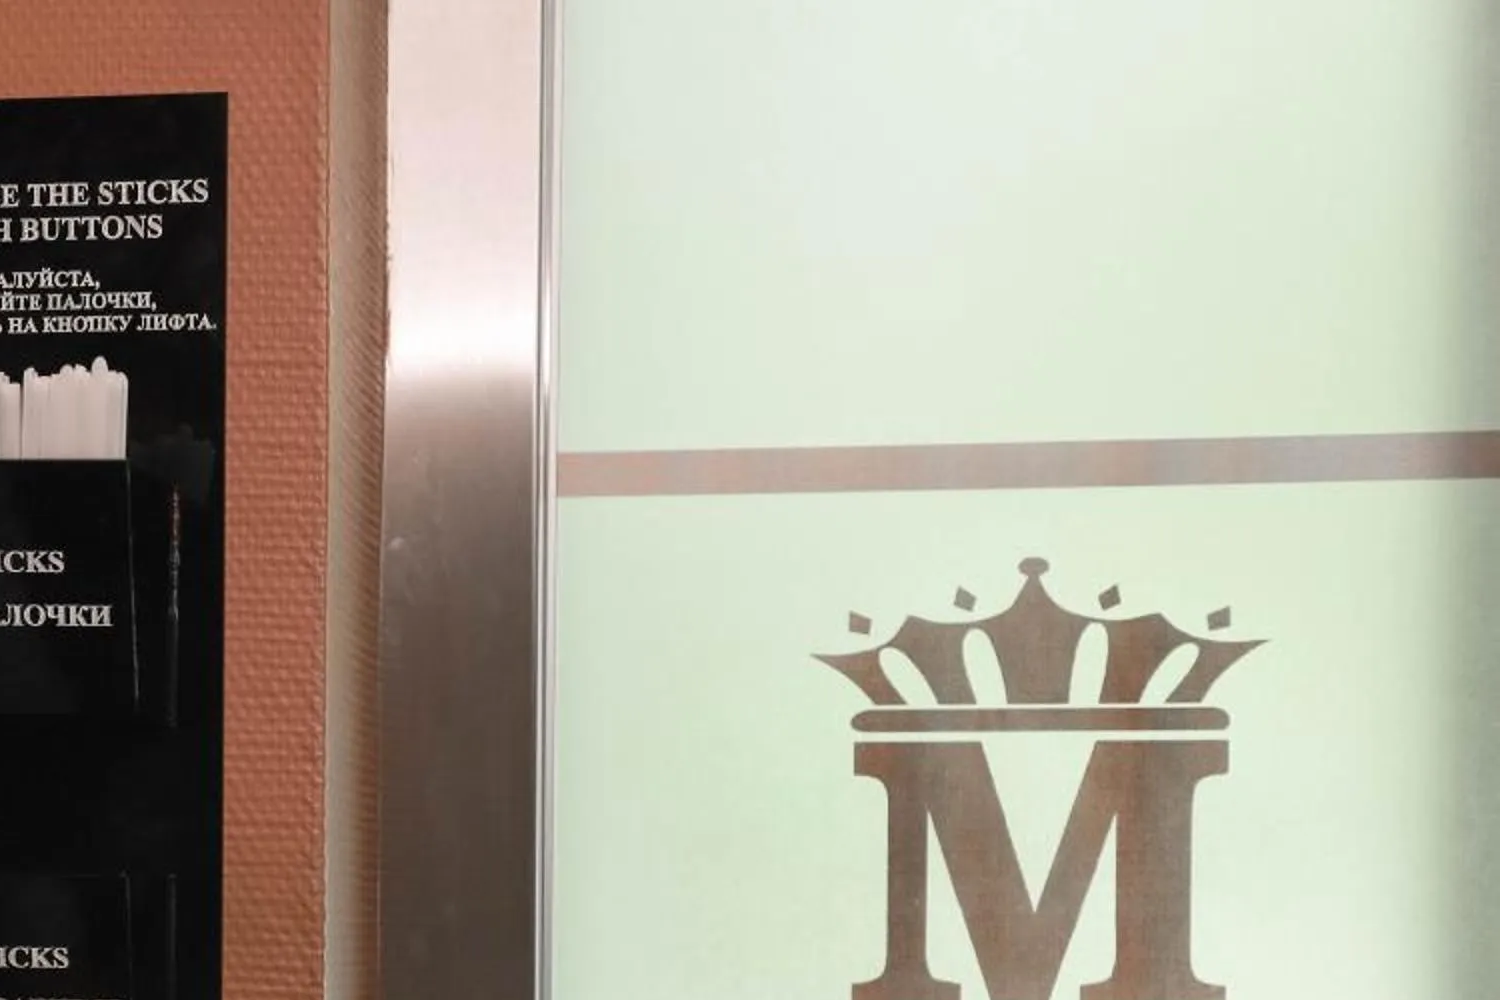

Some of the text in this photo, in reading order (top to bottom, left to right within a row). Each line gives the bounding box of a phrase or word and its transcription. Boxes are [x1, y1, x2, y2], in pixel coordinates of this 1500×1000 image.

[27, 182, 90, 207] THE
[98, 179, 208, 205] STICKS
[20, 214, 162, 242] BUTTONS
[46, 292, 156, 311] ПАЛОЧКИ,
[8, 317, 38, 334] НА
[42, 315, 132, 333] КНОПКУ
[136, 313, 216, 331] ЛИФТА.
